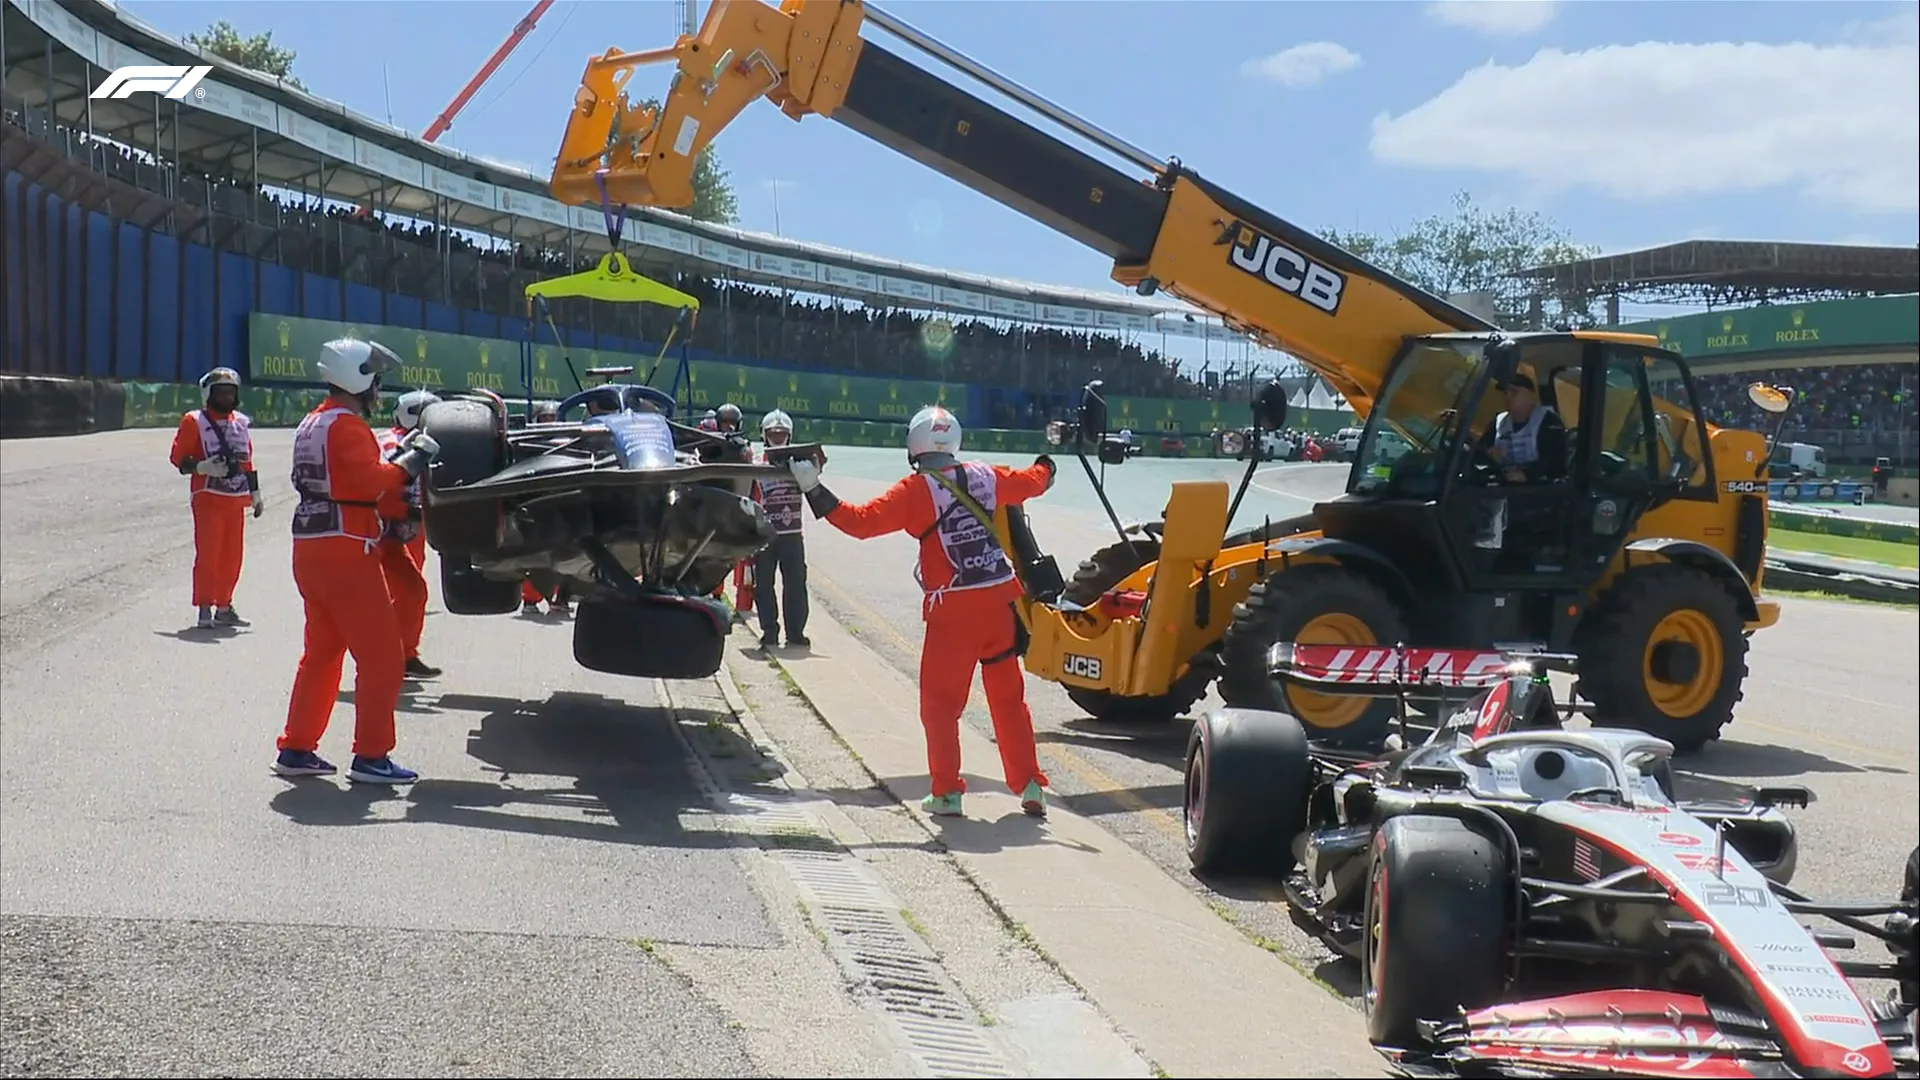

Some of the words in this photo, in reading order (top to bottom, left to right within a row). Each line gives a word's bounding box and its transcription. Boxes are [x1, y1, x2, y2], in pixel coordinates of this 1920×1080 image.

[1232, 236, 1342, 311] JCB
[1707, 334, 1748, 348] ROLEX
[1775, 329, 1819, 342] ROLEX
[264, 356, 307, 377] ROLEX
[402, 365, 444, 386] ROLEX
[467, 372, 504, 390] ROLEX
[727, 391, 758, 407] ROLEX
[777, 397, 810, 411] ROLEX
[829, 400, 860, 415] ROLEX
[879, 404, 908, 417] ROLEX
[1064, 655, 1100, 679] JCB
[1701, 882, 1771, 907] 20
